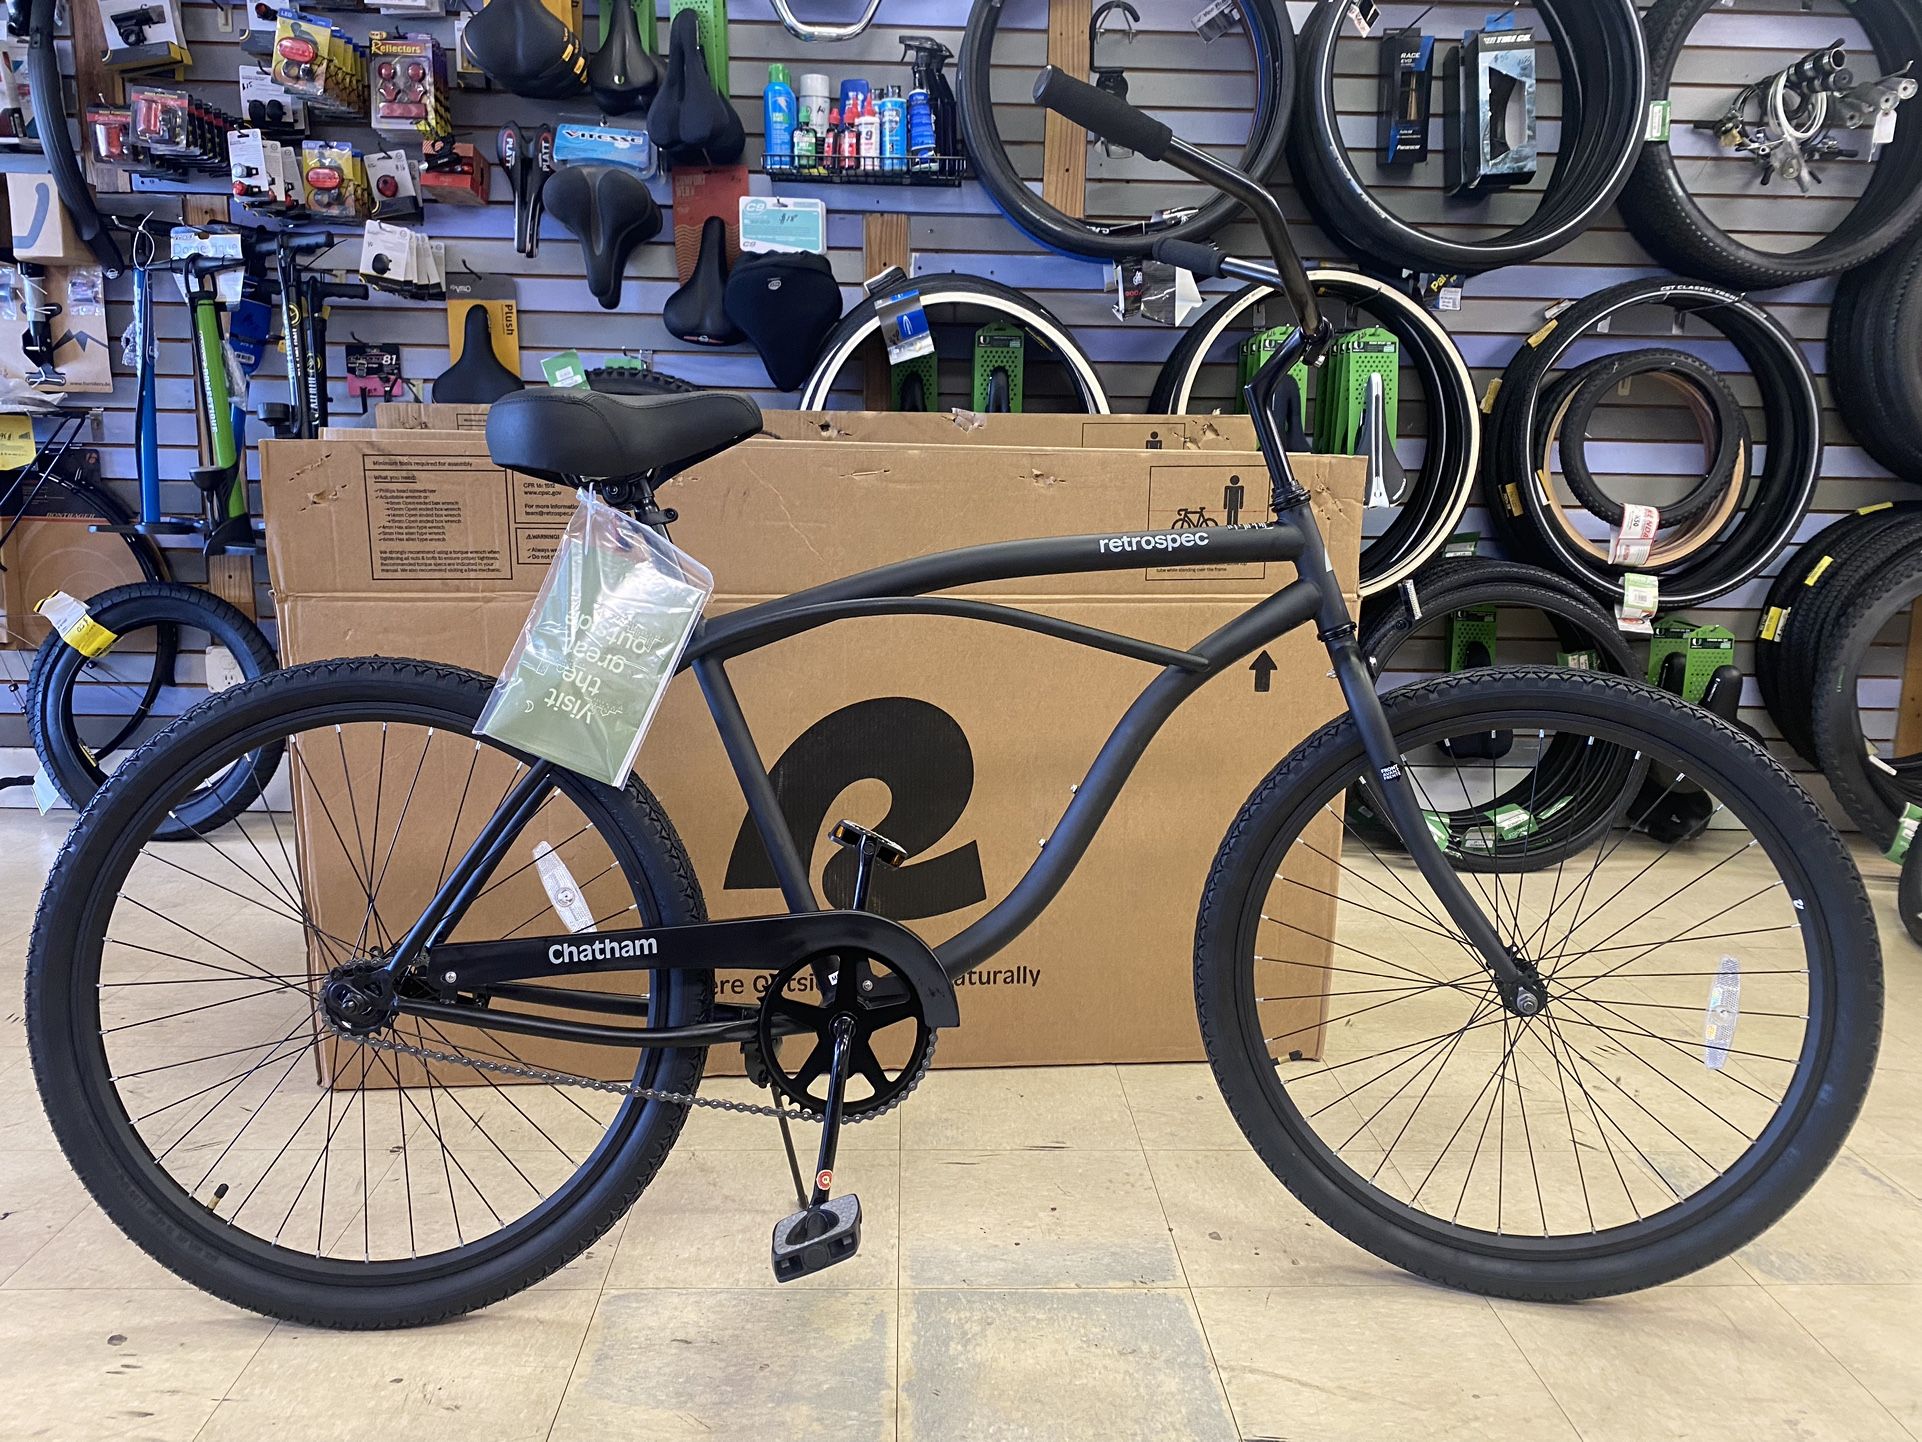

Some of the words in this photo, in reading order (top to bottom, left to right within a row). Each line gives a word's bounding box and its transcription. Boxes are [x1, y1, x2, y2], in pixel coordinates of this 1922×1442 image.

[371, 39, 421, 55] Reflectors
[542, 141, 550, 172] PLATT
[1677, 285, 1713, 293] CLASSIC
[504, 304, 515, 336] Plush
[382, 354, 397, 365] 81
[1099, 531, 1210, 553] retrospec
[562, 667, 601, 696] the
[543, 688, 592, 725] Visit
[548, 937, 658, 965] Chatham
